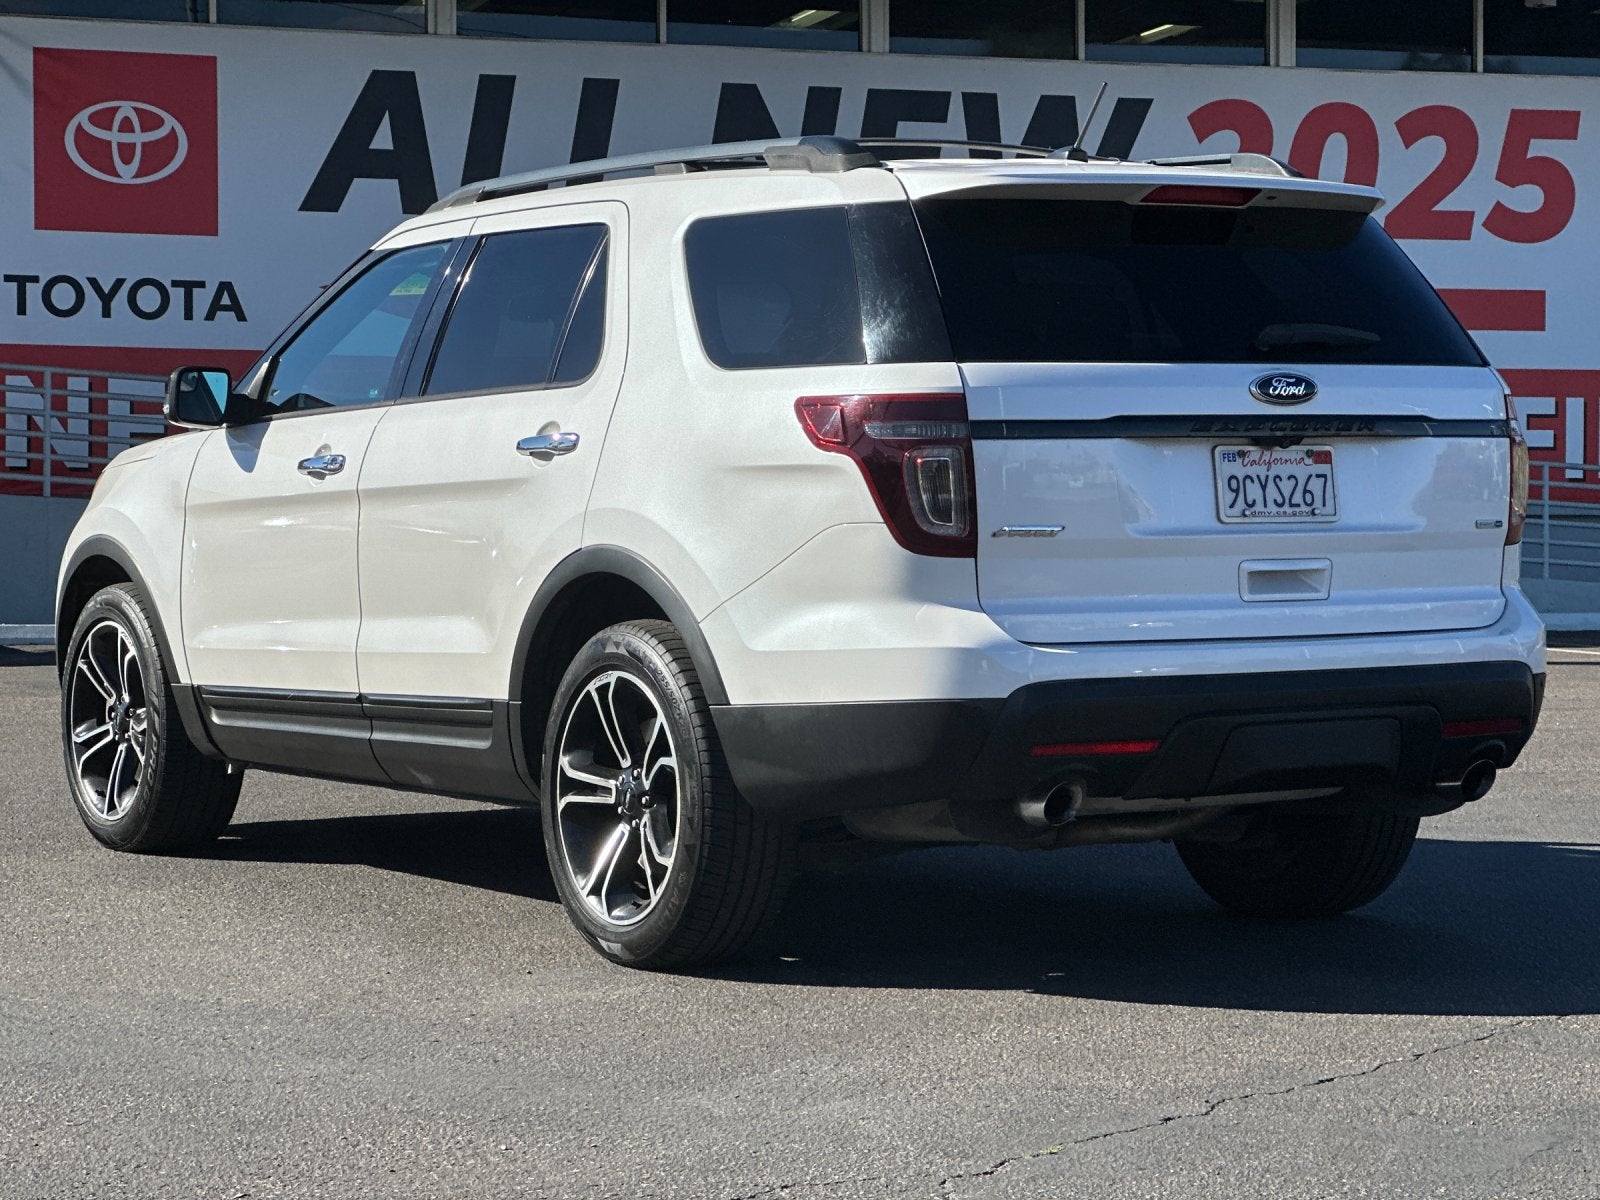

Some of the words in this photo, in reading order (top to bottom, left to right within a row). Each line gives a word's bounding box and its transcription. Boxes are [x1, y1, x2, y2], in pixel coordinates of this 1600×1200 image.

[298, 69, 621, 214] ALL
[3, 274, 248, 322] TOYOTA
[1269, 377, 1306, 396] Ford
[1222, 452, 1238, 463] FEB
[1241, 450, 1313, 472] California
[1227, 473, 1329, 509] 9CYS267
